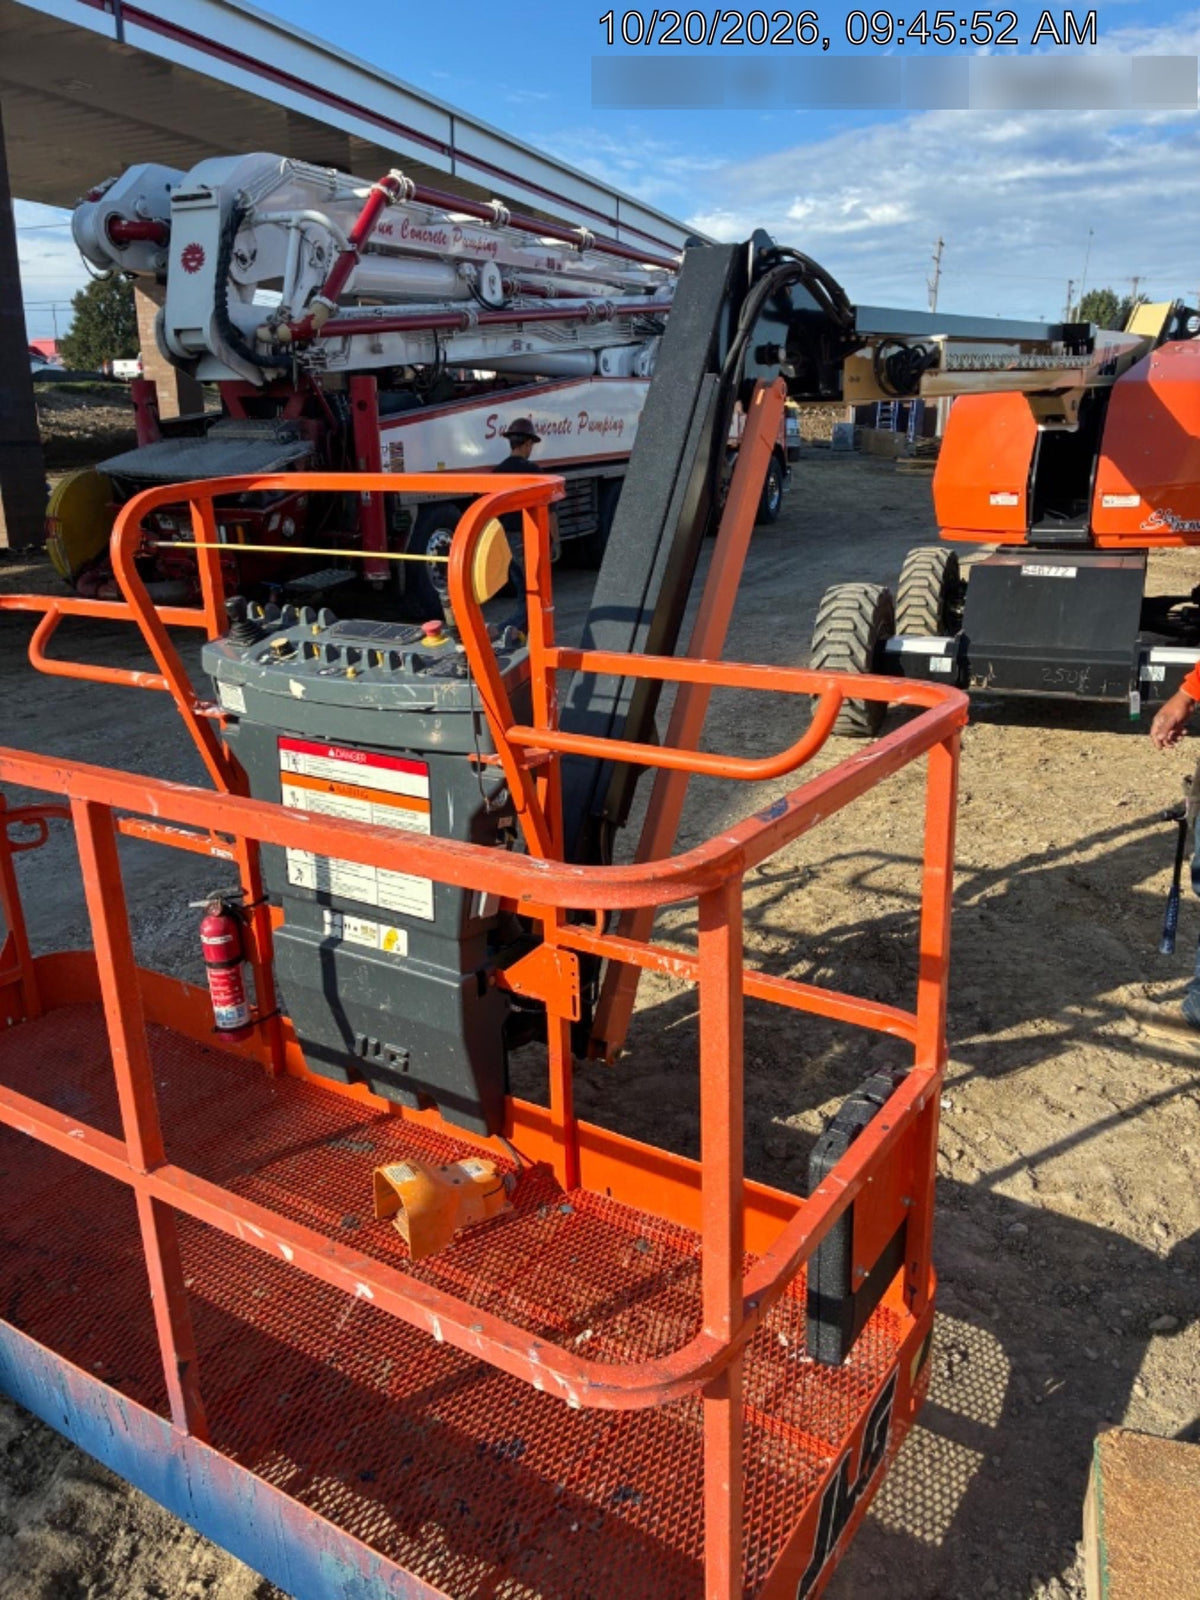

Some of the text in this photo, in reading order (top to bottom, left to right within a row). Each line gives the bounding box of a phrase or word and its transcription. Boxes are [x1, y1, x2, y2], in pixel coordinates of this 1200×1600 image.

[401, 218, 447, 245] Concrete
[452, 226, 498, 258] Pumping
[484, 410, 624, 440] Su oncrete Pumping
[335, 748, 368, 764] DANGER
